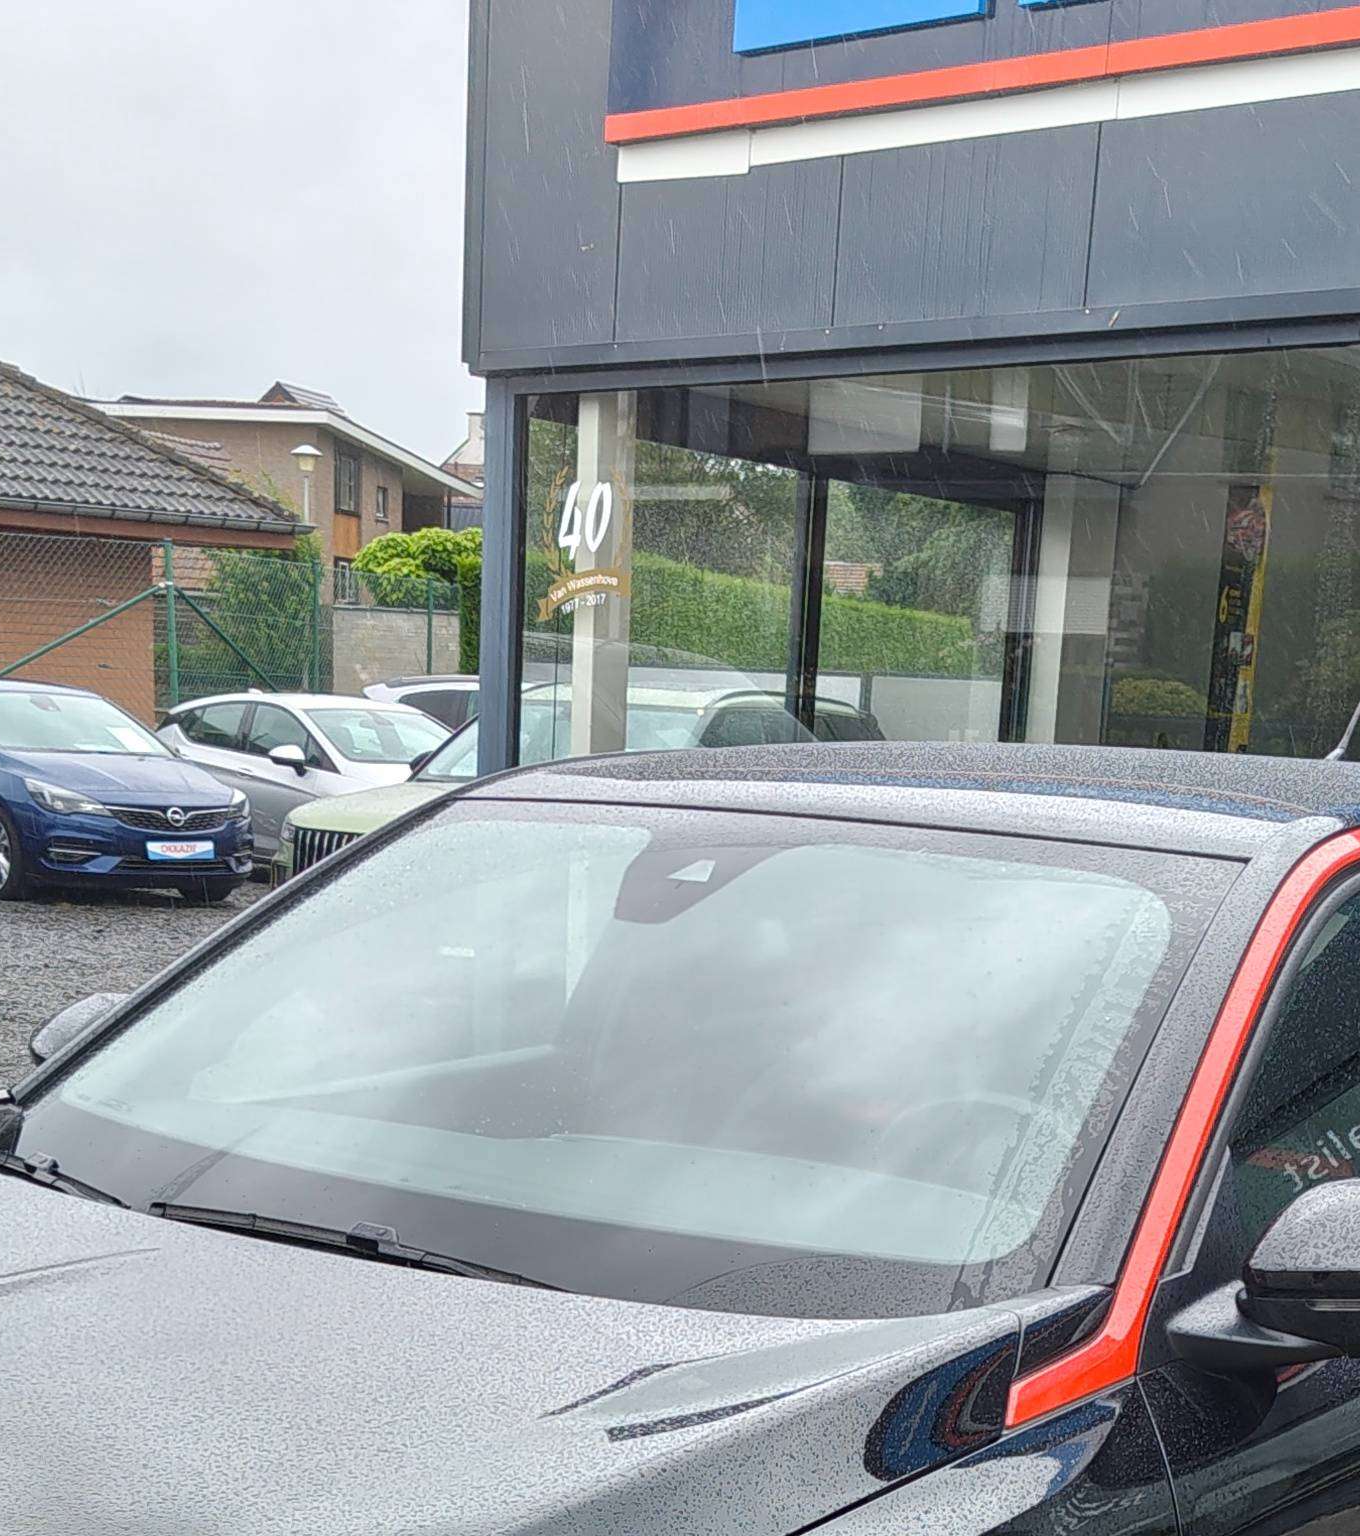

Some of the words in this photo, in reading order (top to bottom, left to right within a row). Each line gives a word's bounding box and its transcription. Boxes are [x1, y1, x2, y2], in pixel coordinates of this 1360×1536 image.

[558, 481, 612, 560] 40
[550, 587, 568, 602] Van
[566, 574, 618, 591] Wassenhove
[586, 593, 606, 606] 2017
